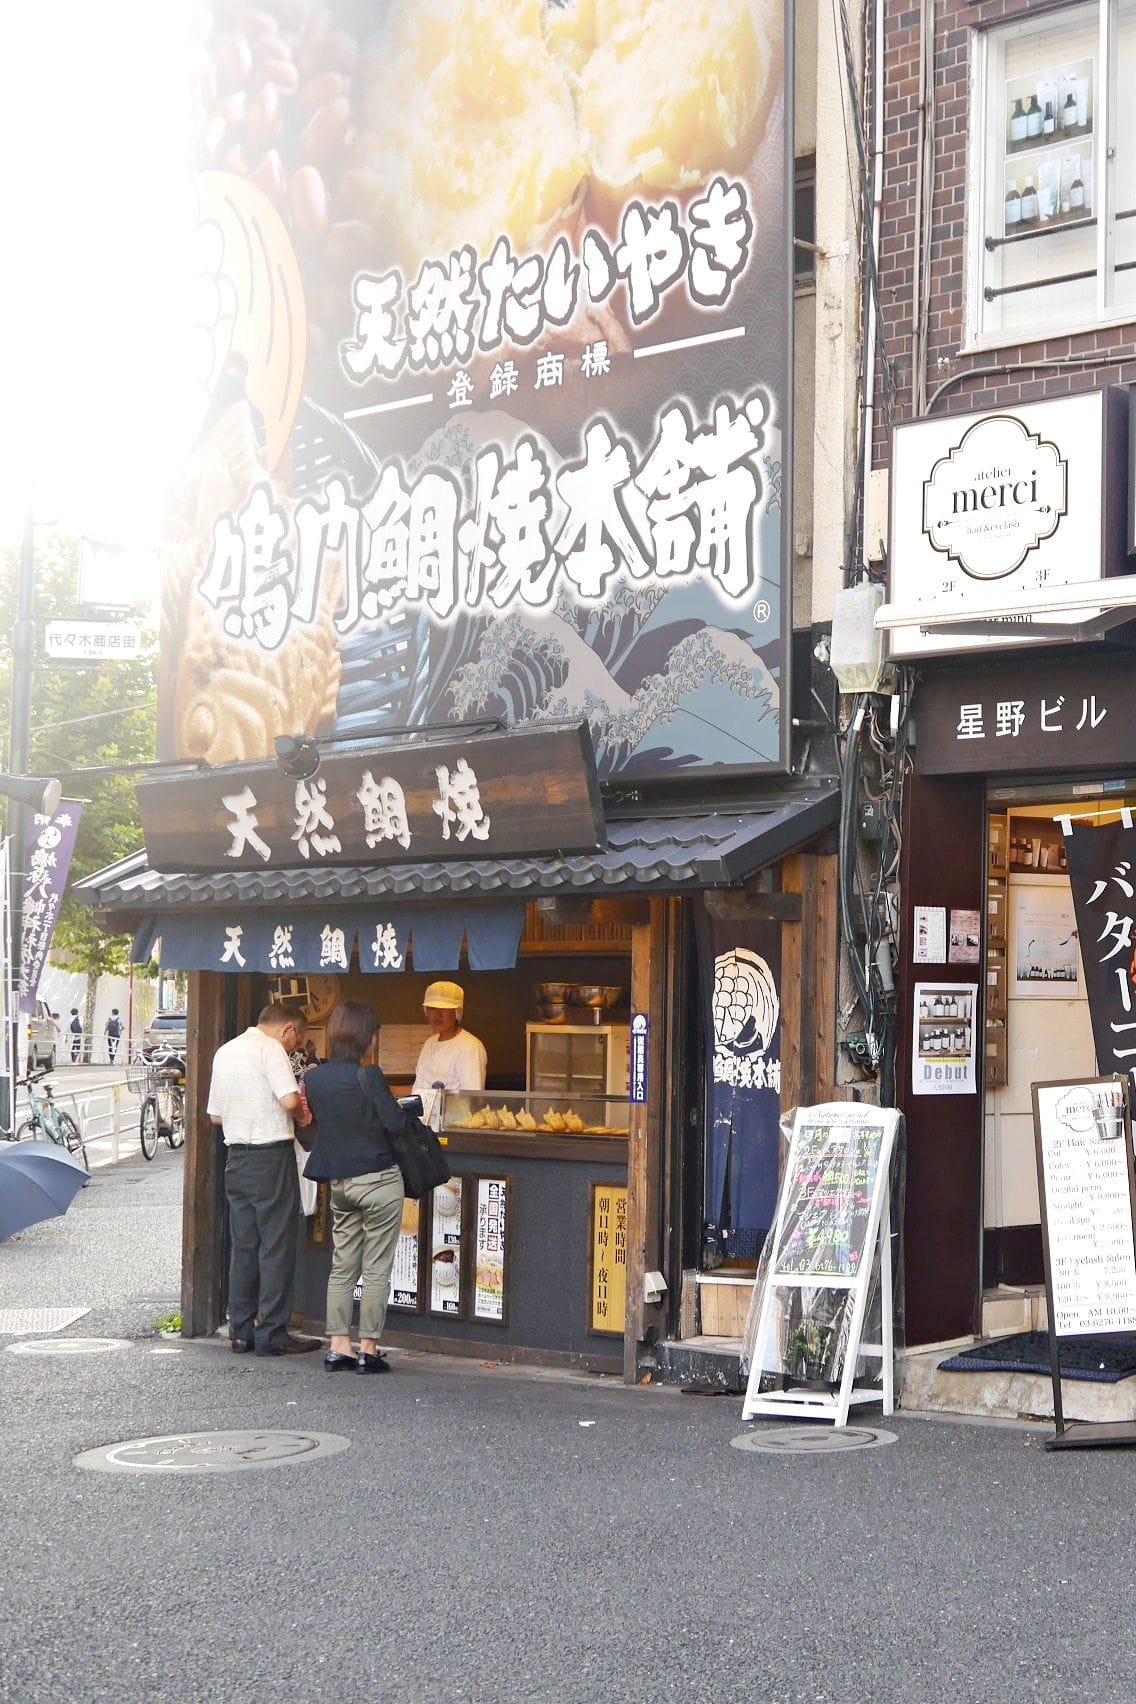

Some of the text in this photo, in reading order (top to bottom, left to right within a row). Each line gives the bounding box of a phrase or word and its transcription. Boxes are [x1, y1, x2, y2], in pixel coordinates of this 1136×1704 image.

[338, 176, 754, 382] 天然たいやき
[446, 340, 612, 410] 登録商標
[952, 469, 1038, 514] merci
[974, 466, 1012, 482] atelier
[198, 384, 772, 650] 鳴門鯛焼本舗
[942, 569, 1051, 593] 2F 3F
[48, 631, 137, 649] 代々木商店街
[957, 696, 1107, 741] 星野ビル
[223, 758, 491, 862] 天然鯛焼
[219, 924, 403, 969] 天然鯛焼
[923, 1064, 968, 1080] Debut
[615, 1199, 627, 1265] 営業時間
